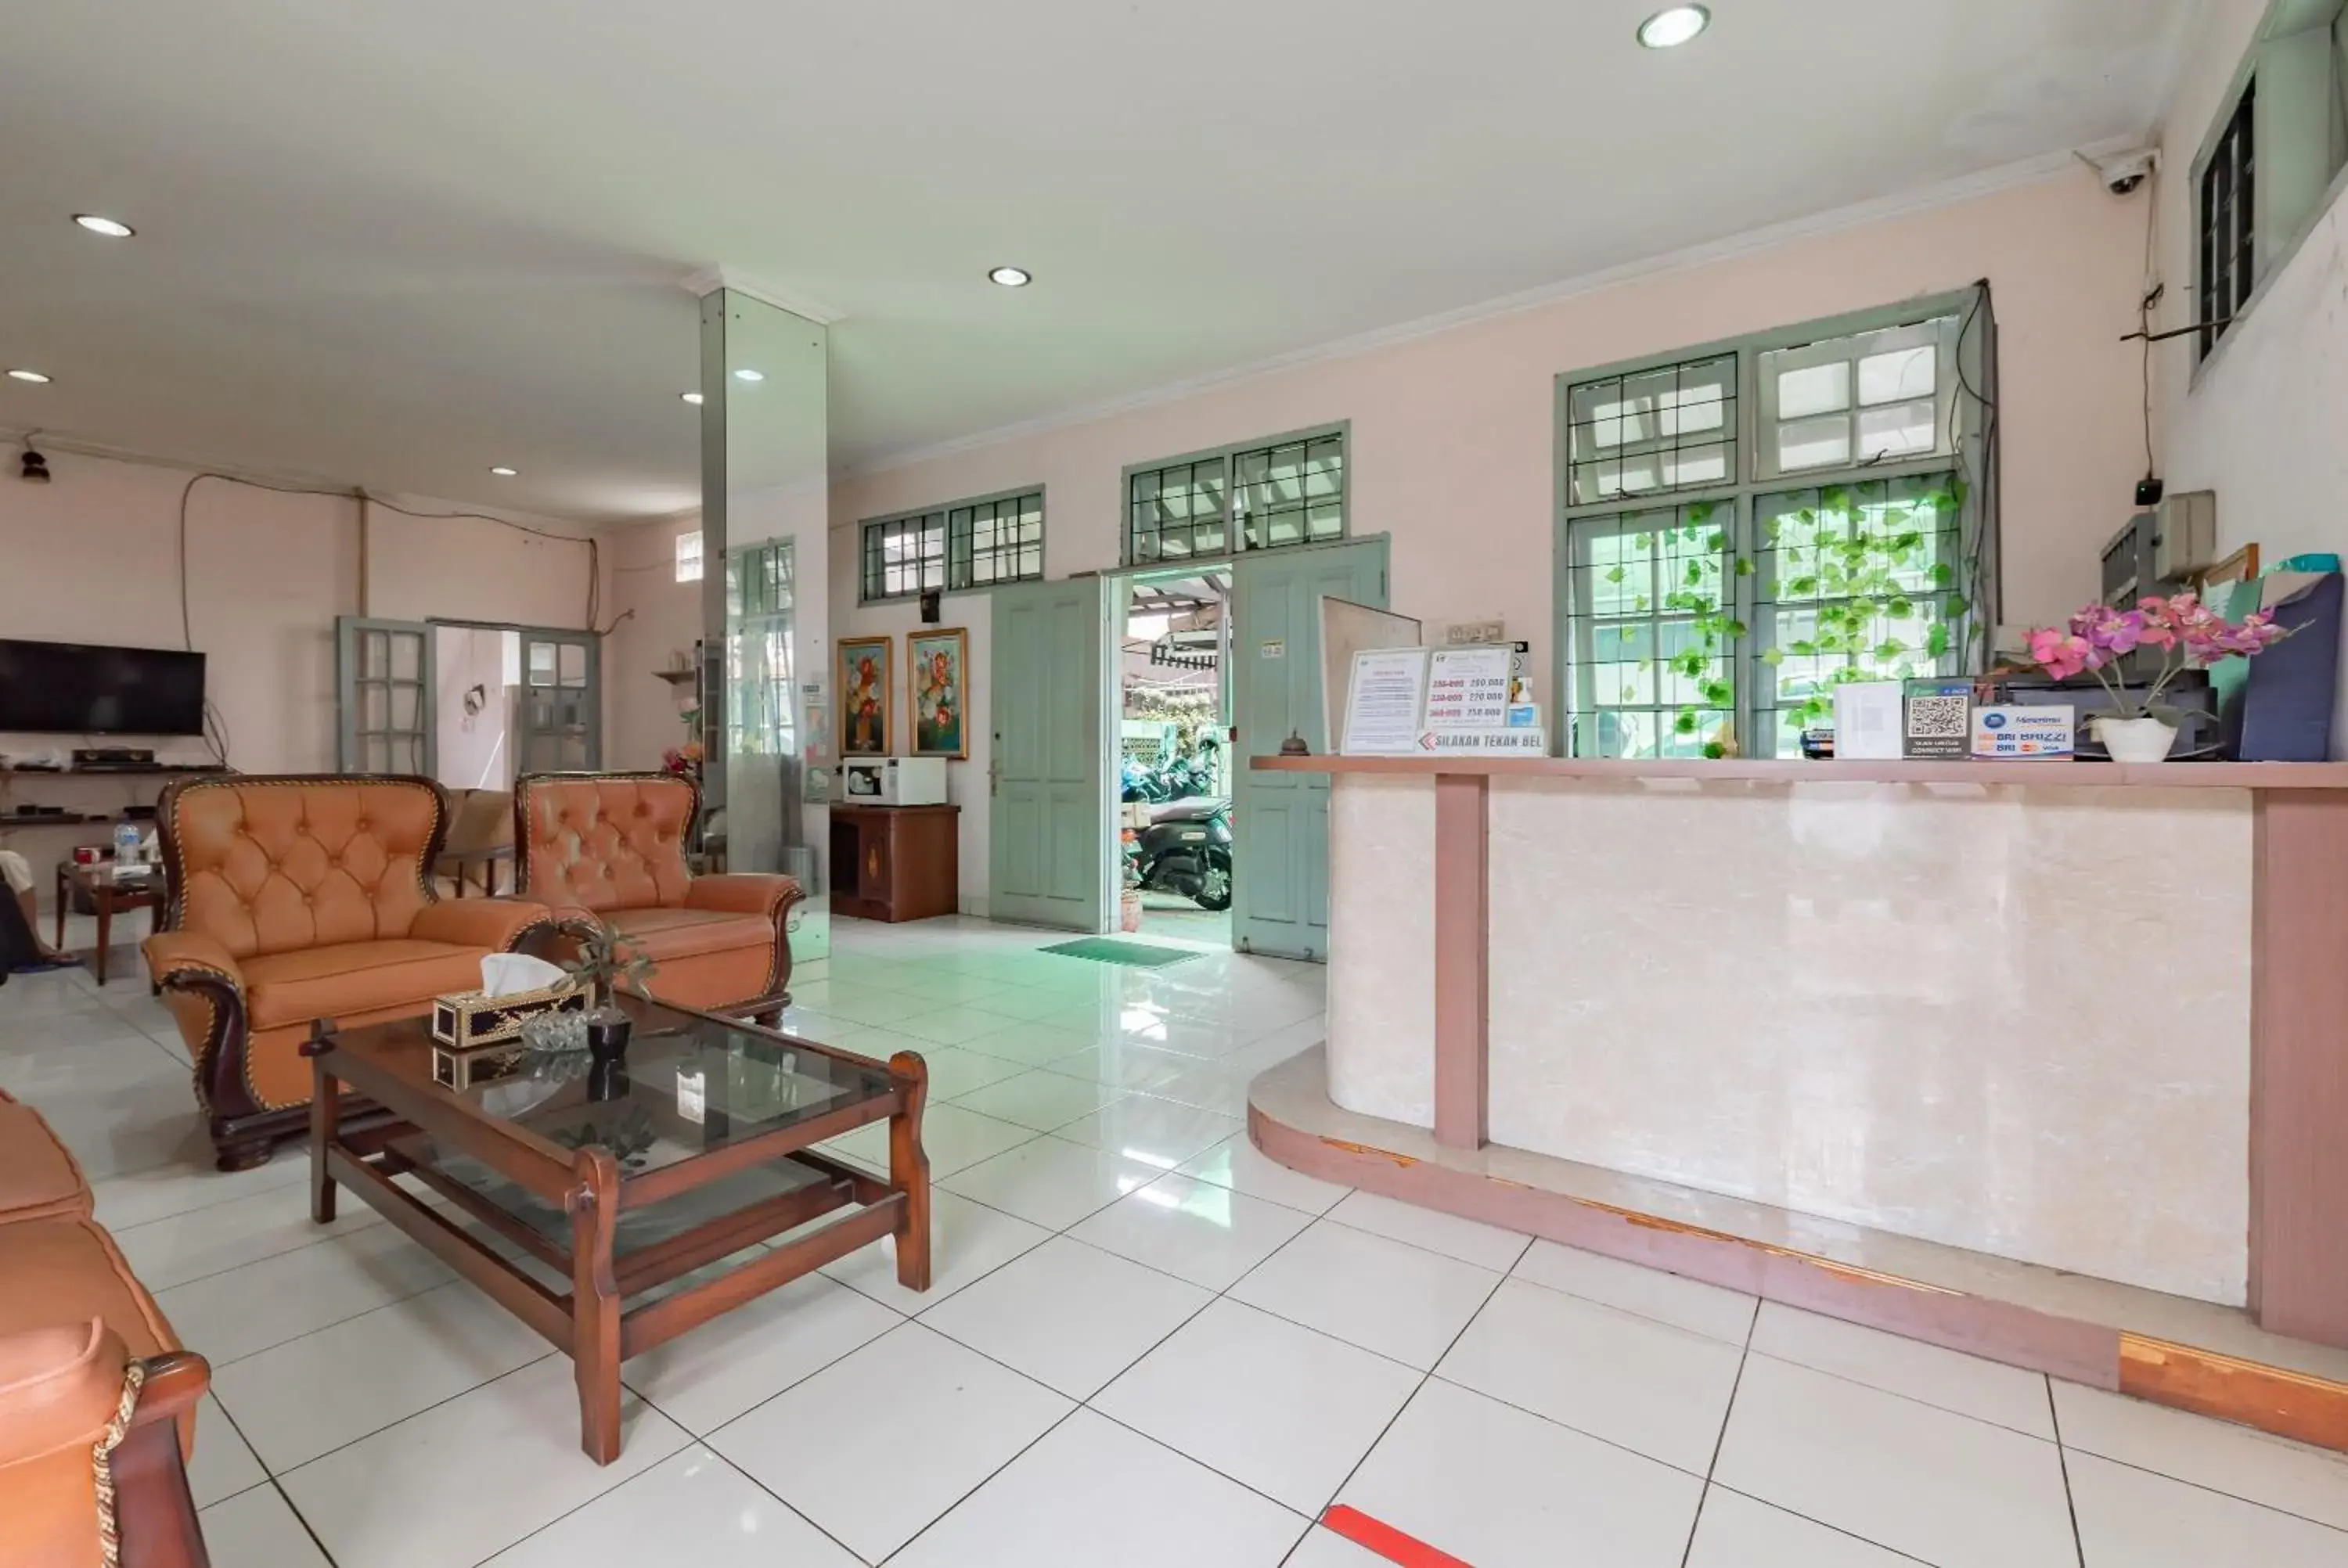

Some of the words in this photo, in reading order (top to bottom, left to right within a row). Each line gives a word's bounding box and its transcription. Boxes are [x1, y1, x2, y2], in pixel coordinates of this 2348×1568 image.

[1436, 735, 1479, 747] SILAKAN
[1484, 734, 1518, 747] TEKAN
[1522, 735, 1543, 747] BEL
